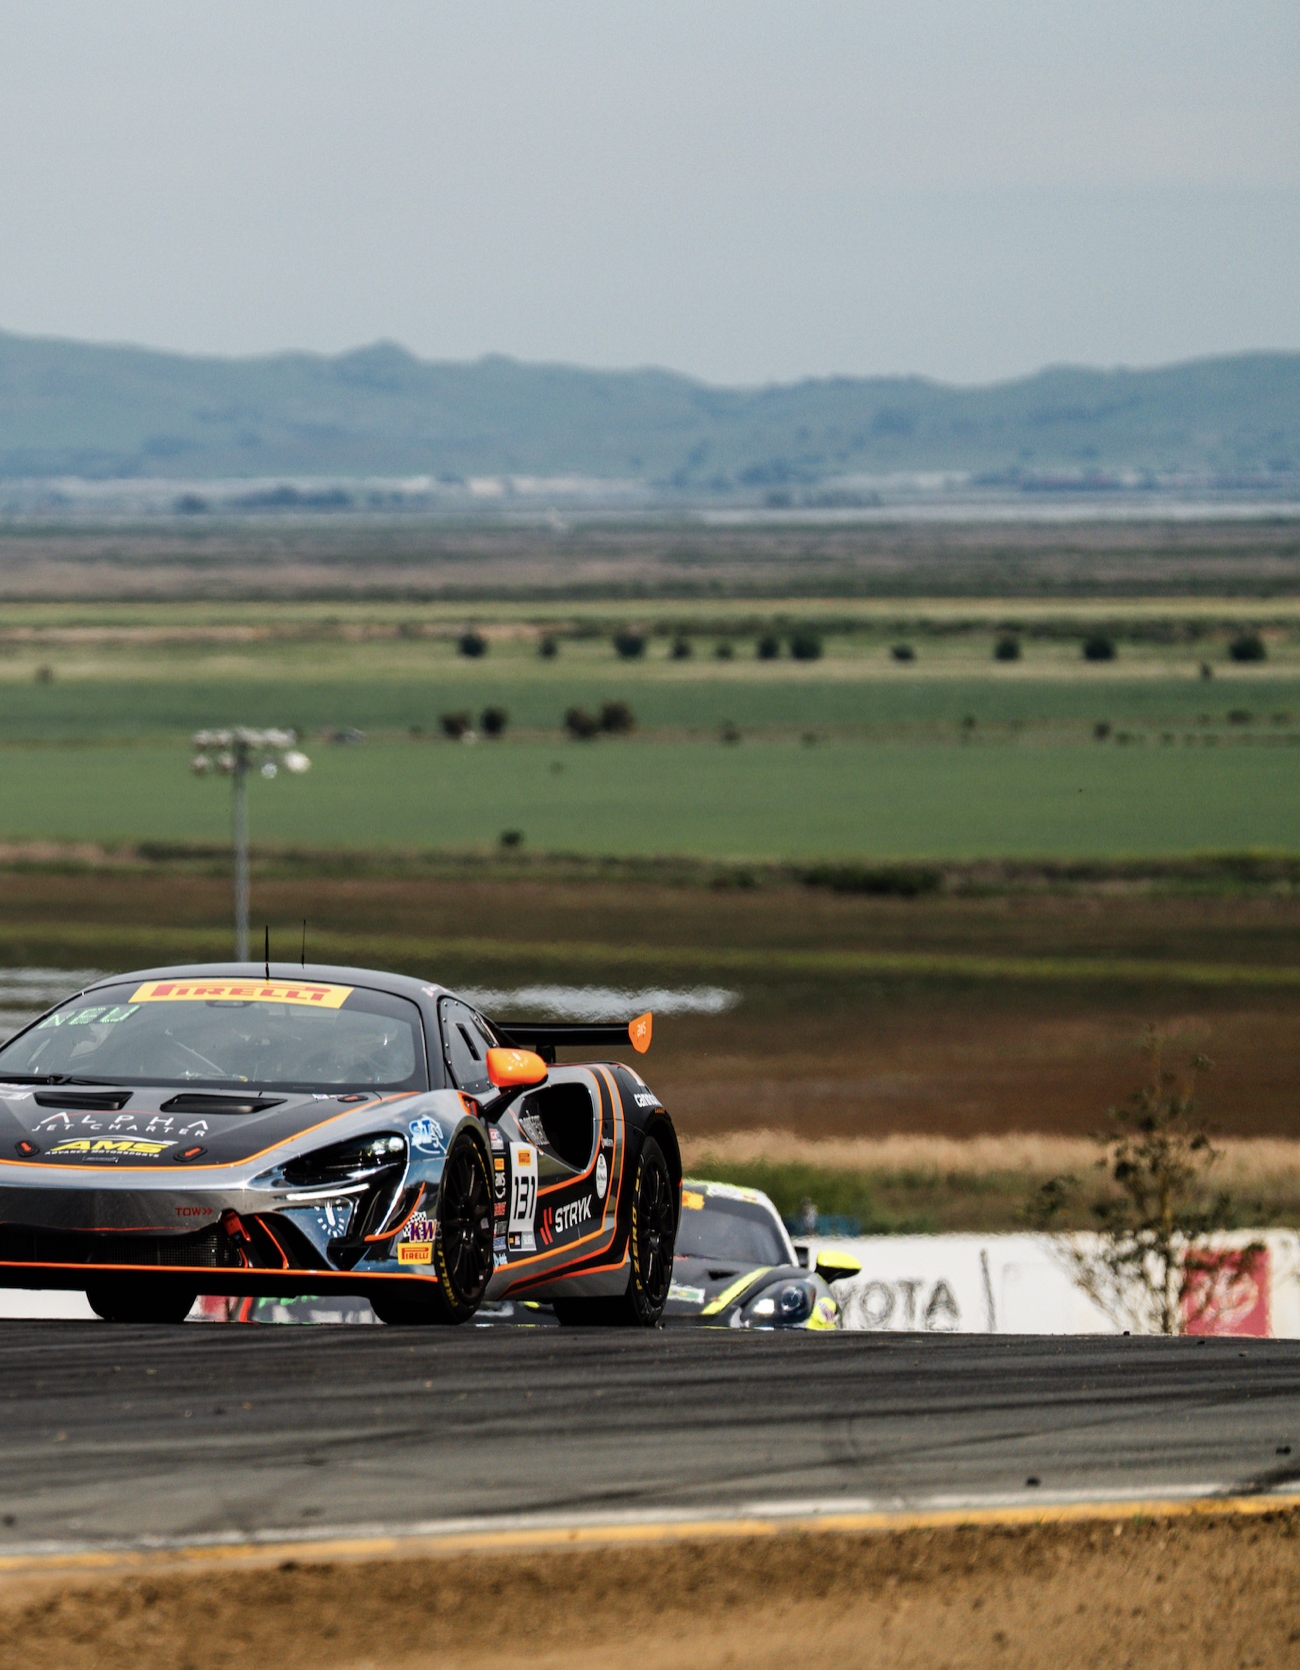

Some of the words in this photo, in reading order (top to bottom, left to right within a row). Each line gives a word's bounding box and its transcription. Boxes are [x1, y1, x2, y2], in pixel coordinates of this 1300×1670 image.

[150, 983, 331, 1002] PIRELLI
[31, 1123, 74, 1132] JET
[90, 1123, 206, 1137] CHARTER
[40, 1111, 209, 1131] ALPHA
[50, 1140, 169, 1154] AMS
[91, 1149, 159, 1158] MOTORSPORTS
[513, 1175, 536, 1219] 131
[554, 1194, 593, 1233] STRYK
[409, 1220, 437, 1242] KW
[401, 1247, 429, 1260] PIRELLI
